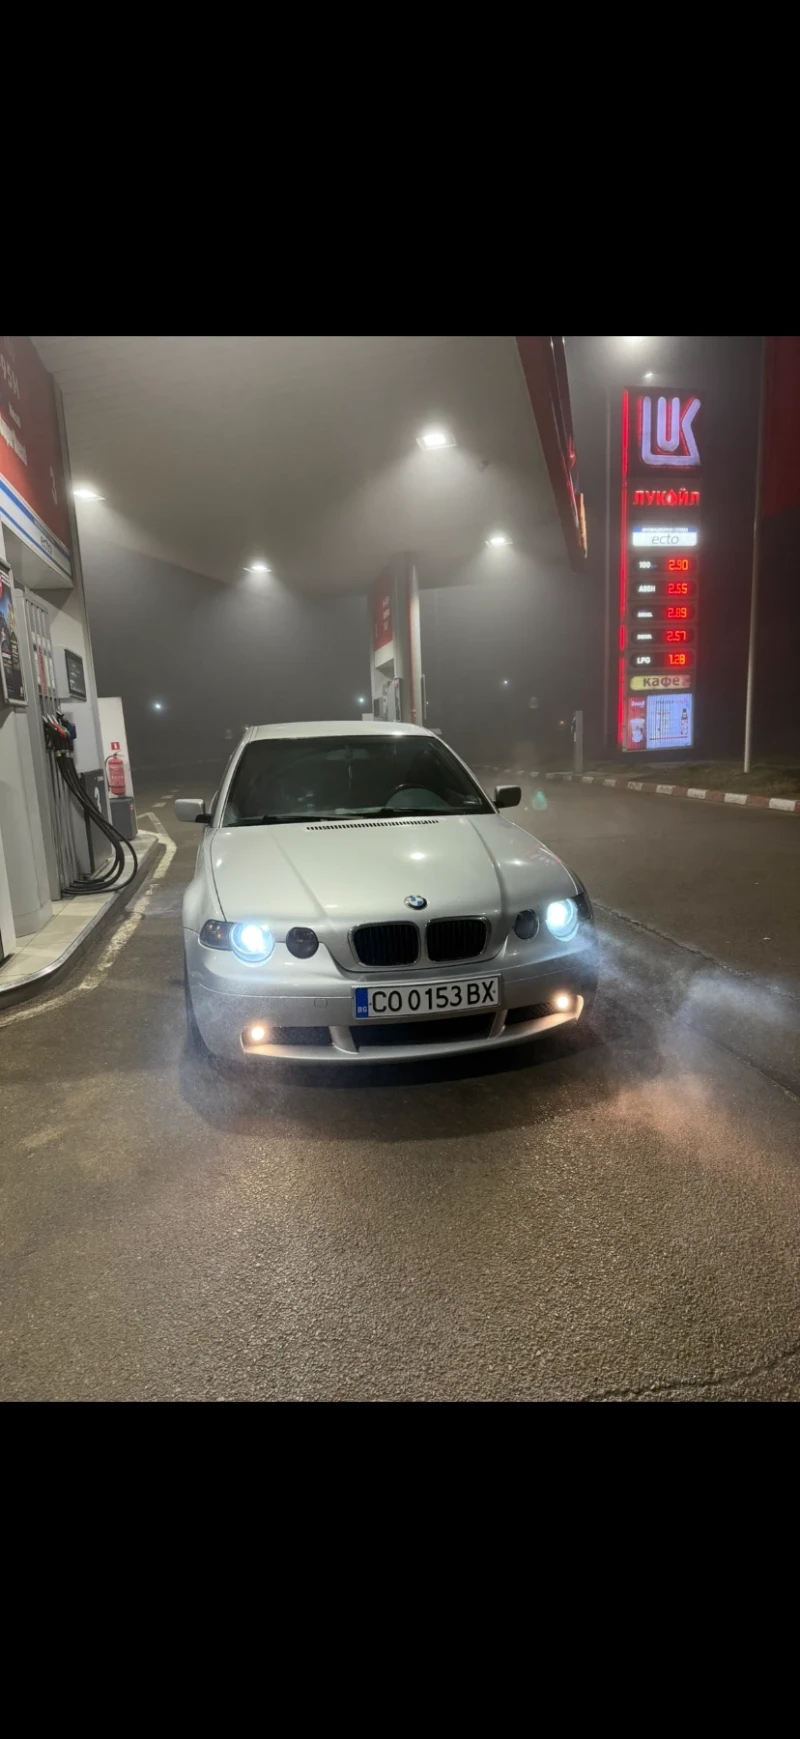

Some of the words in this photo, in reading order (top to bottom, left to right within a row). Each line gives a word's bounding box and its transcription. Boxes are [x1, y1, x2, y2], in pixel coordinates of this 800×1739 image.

[641, 396, 701, 466] LUK
[632, 487, 700, 506] ЛУКОЙЛ
[651, 534, 680, 545] ecto
[638, 561, 651, 569] 100
[668, 559, 689, 571] 2.90
[668, 583, 688, 594] 2.55
[667, 607, 687, 618] 2.89
[667, 630, 686, 641] 2.57
[637, 656, 651, 665] LPG
[668, 654, 686, 665] 1.28
[643, 676, 680, 687] кафе
[372, 990, 402, 1013] CO
[408, 986, 462, 1011] 0153
[467, 980, 495, 1005] BX
[357, 1006, 367, 1014] BG
